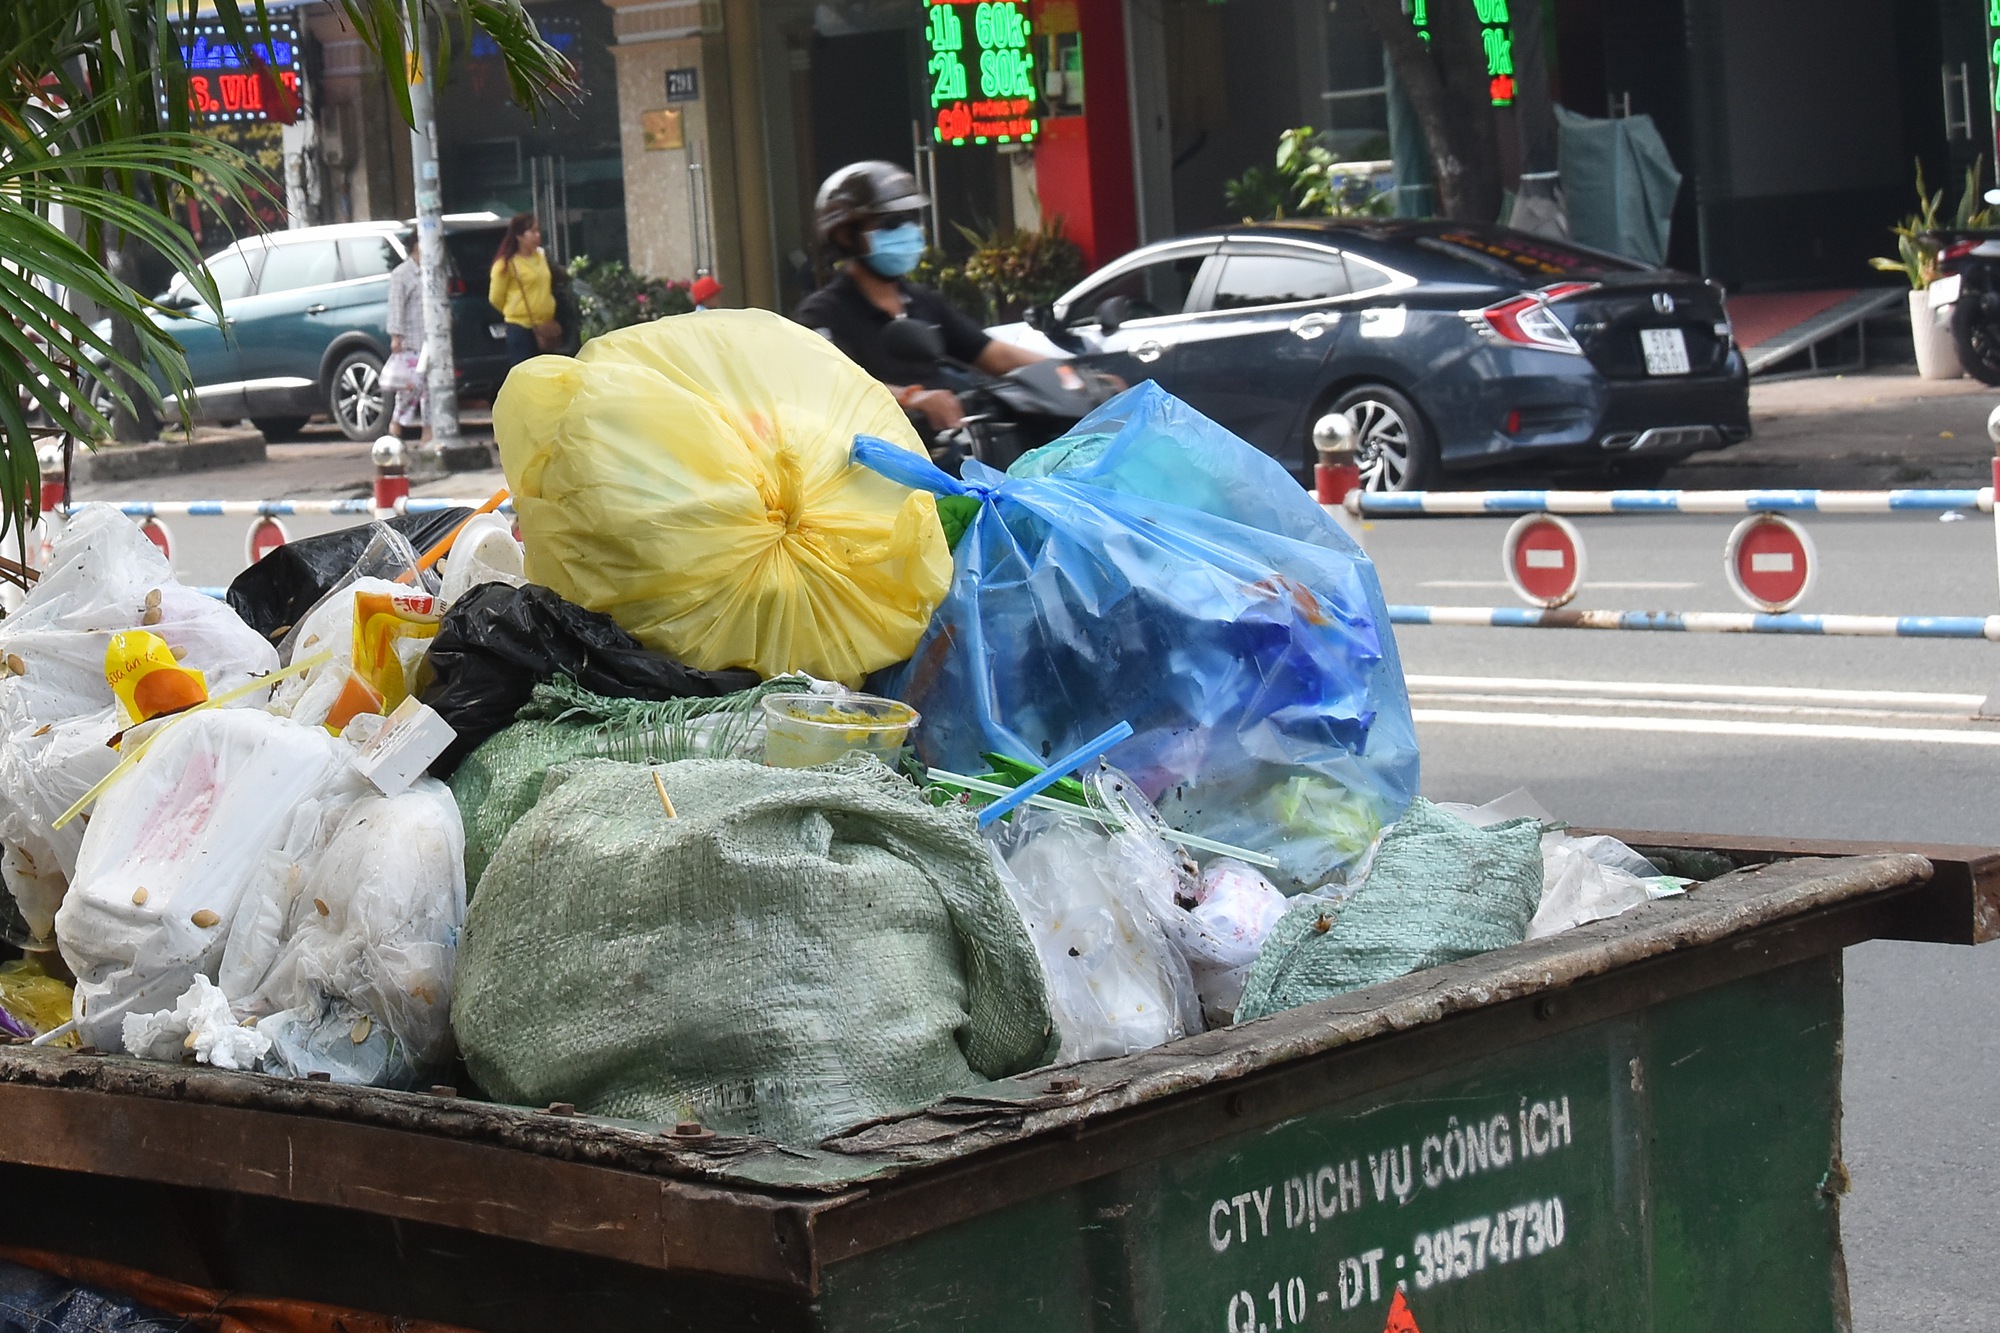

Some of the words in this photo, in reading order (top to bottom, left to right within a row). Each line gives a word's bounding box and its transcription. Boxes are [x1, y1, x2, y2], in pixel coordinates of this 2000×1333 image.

[930, 4, 962, 50] 1h
[976, 2, 1026, 49] 60k
[933, 51, 967, 99] 2h
[980, 49, 1030, 97] 80k
[1209, 1186, 1273, 1253] CTY
[1284, 1160, 1361, 1234] DỊCH
[1368, 1144, 1412, 1205] VỤ
[1421, 1115, 1513, 1188] CÔNG
[1520, 1096, 1572, 1159] ÍCH
[1227, 1276, 1307, 1333] Q.10
[1414, 1197, 1566, 1290] 39574730
